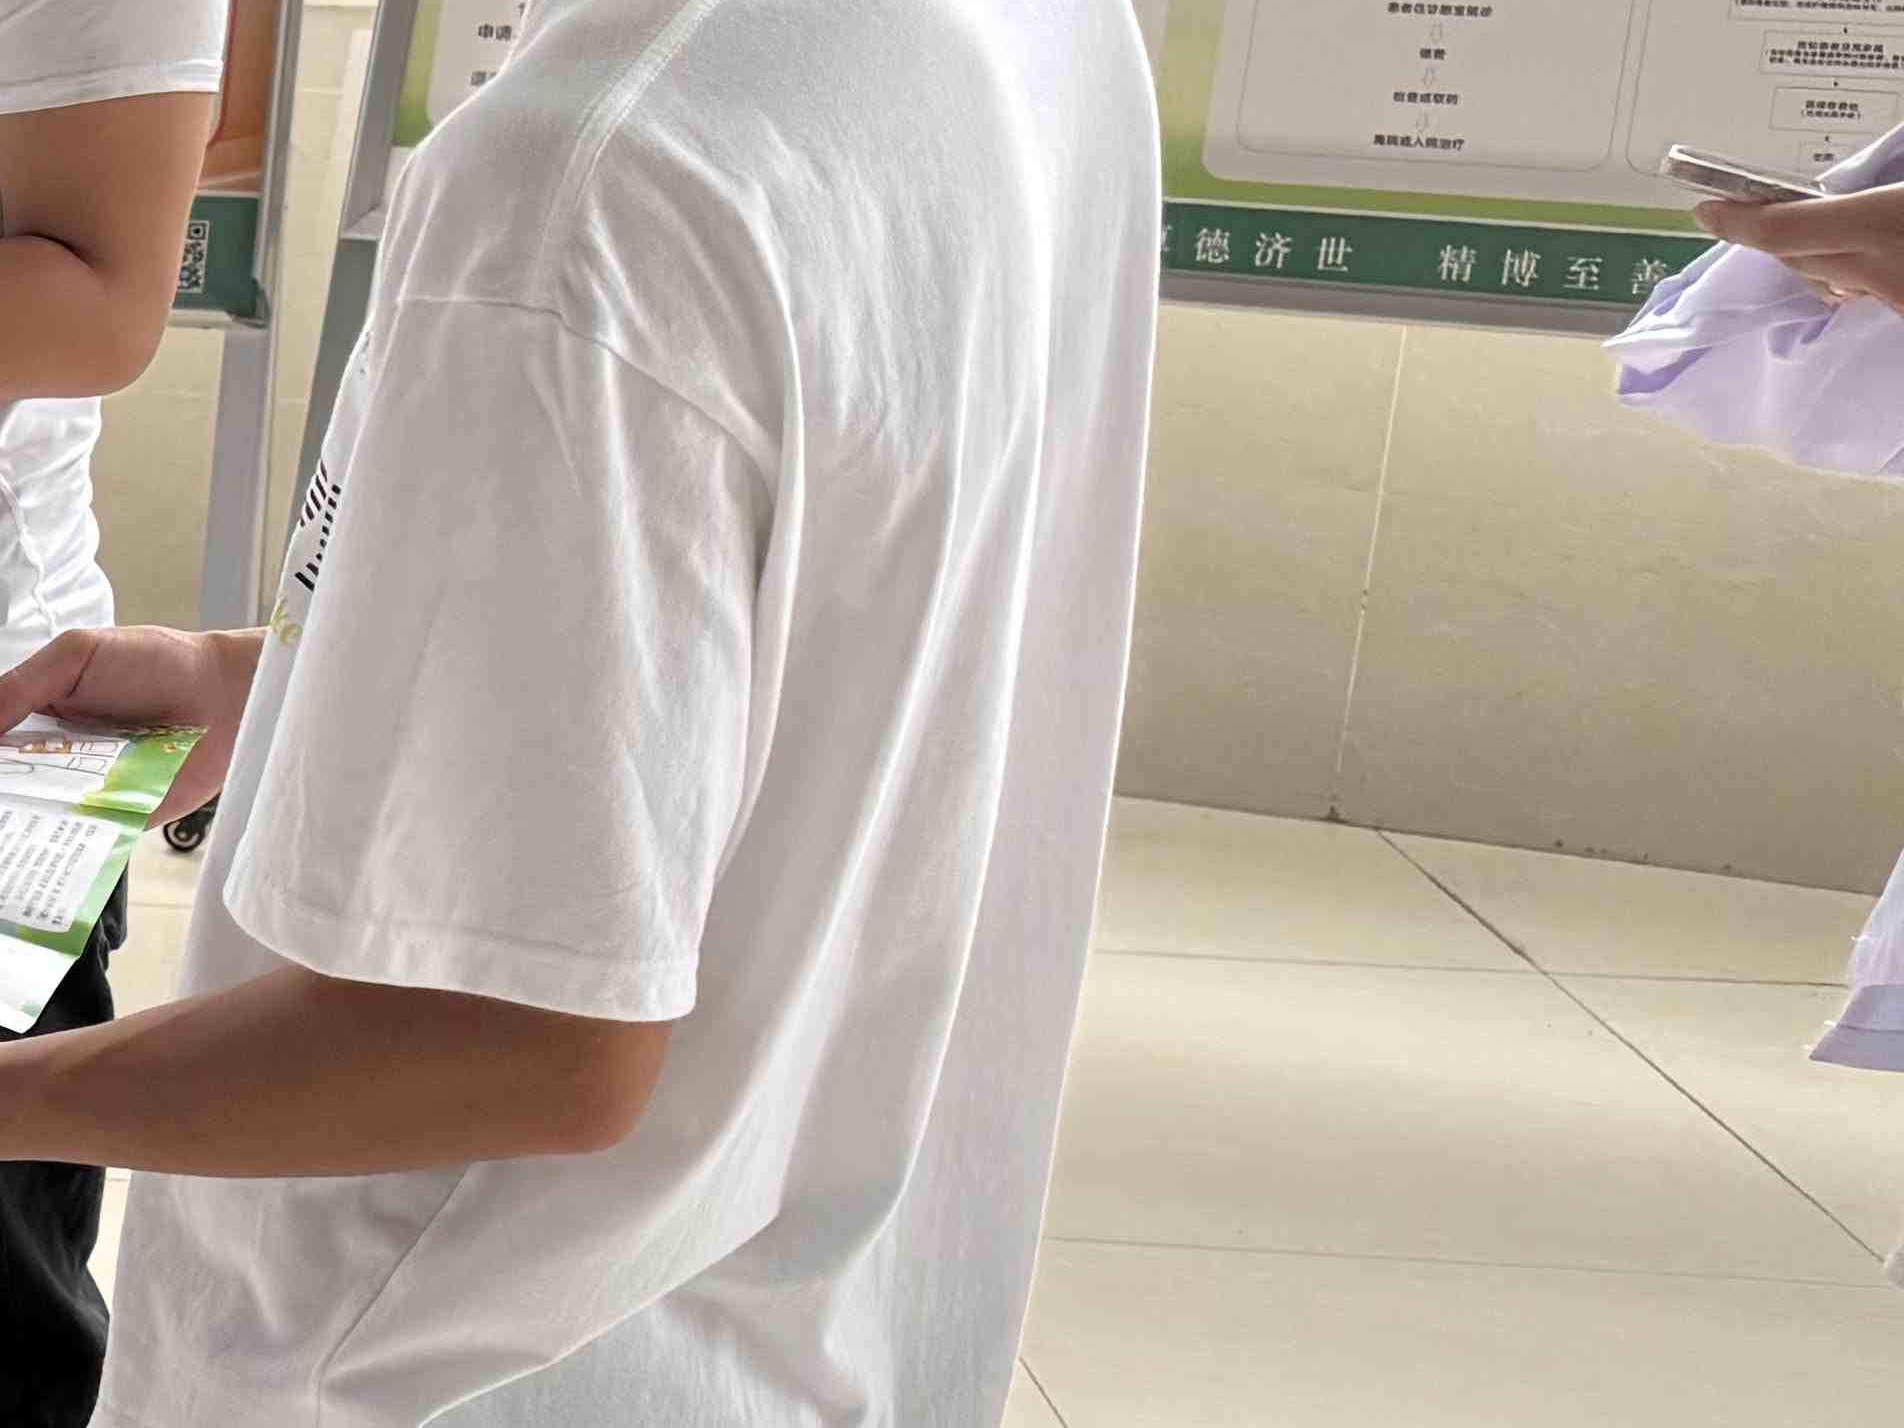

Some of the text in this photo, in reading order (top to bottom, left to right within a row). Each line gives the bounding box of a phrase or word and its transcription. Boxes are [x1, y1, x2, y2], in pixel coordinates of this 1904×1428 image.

[1160, 226, 1669, 295] 德济世 精博至善
